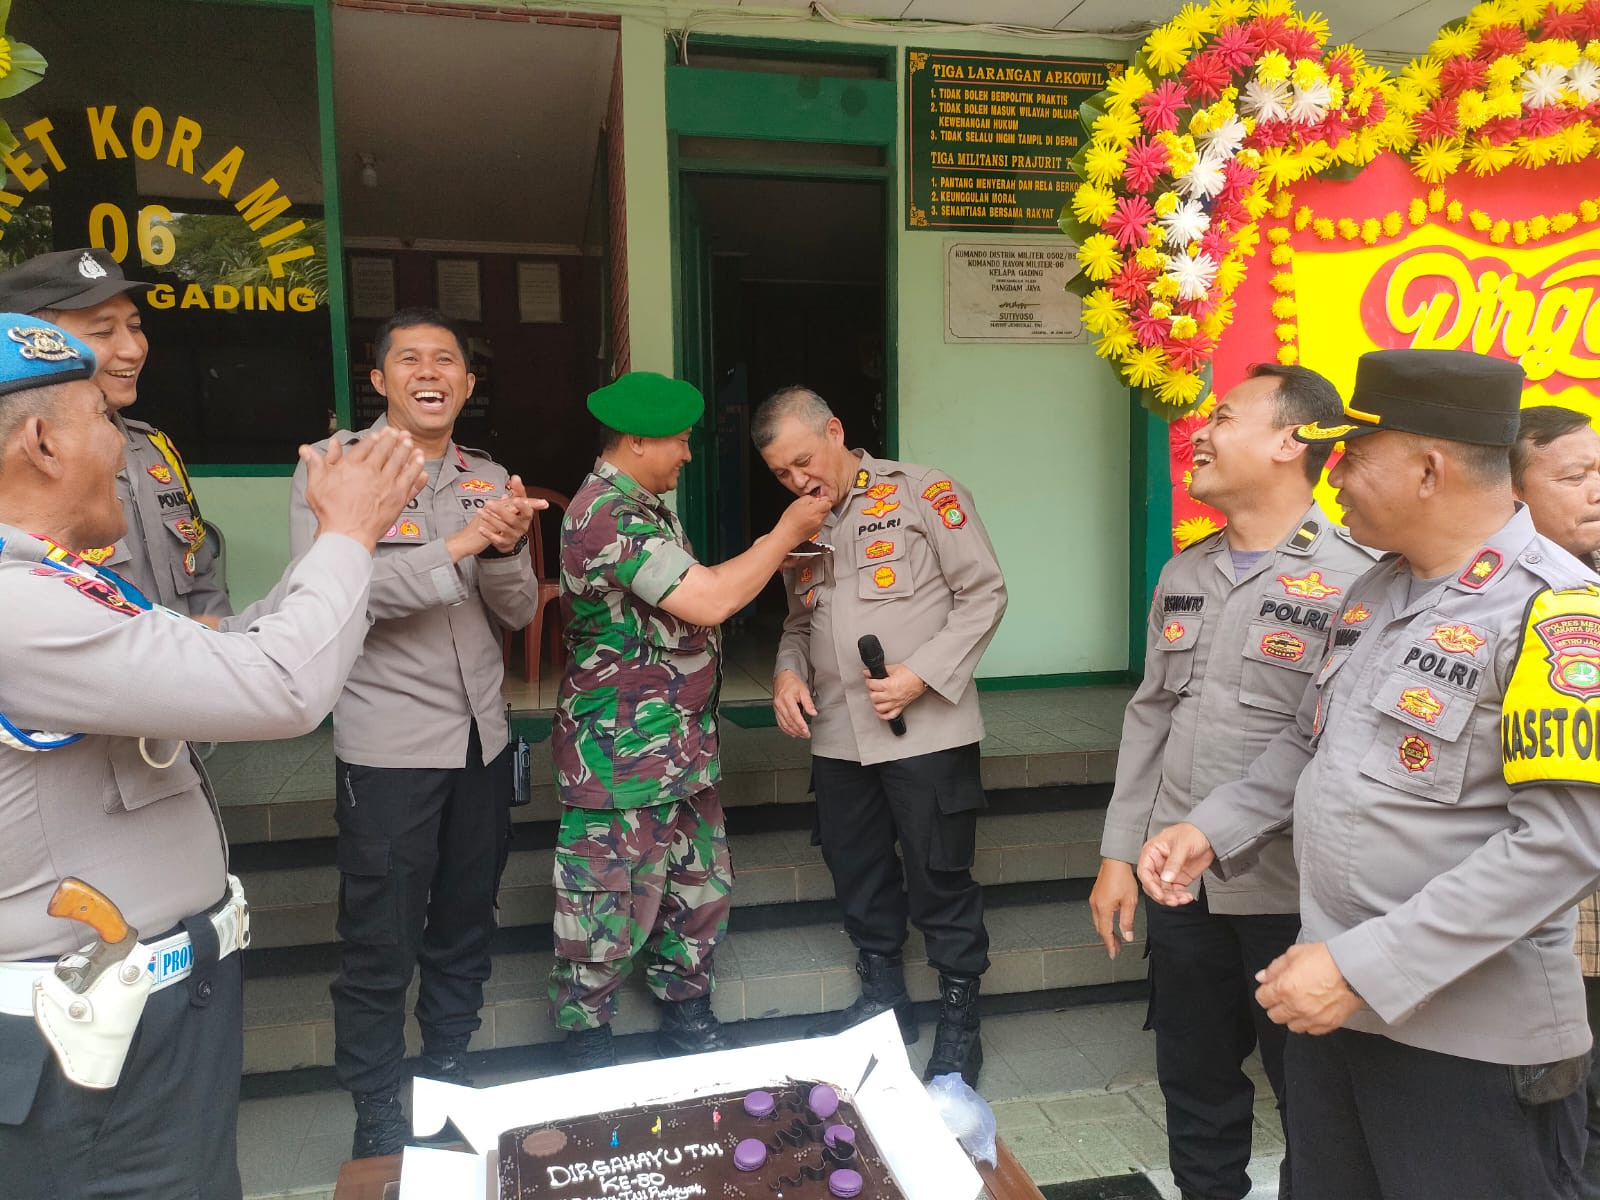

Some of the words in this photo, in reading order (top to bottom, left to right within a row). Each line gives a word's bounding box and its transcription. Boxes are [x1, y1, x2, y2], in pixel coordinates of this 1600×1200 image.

[932, 64, 964, 78] TIGA
[968, 67, 1042, 82] LARANGAN
[930, 89, 936, 98] 1.
[939, 88, 961, 99] TIDAK
[964, 89, 988, 100] BOLEH
[991, 91, 1033, 103] BERPOLITIK
[1036, 94, 1068, 106] PRAKTIS
[930, 102, 937, 112] 2.
[939, 102, 961, 114] TIDAK
[964, 104, 988, 114] BOLEH
[991, 105, 1016, 116] MASUK
[1019, 106, 1050, 118] WILAYAH
[1052, 108, 1078, 120] DILUAR
[939, 116, 990, 130] KEWENANGAN
[993, 119, 1018, 130] HUKUM
[930, 130, 937, 140] 3.
[940, 130, 962, 141] TIDAK
[966, 131, 992, 142] SELALU
[996, 134, 1015, 144] INGIN
[1018, 134, 1042, 146] TAMPIL
[1046, 136, 1052, 146] DI
[1056, 136, 1078, 147] DEPAN
[931, 152, 954, 165] TIGA
[958, 153, 1008, 166] MILITANSI
[1012, 155, 1061, 168] PRAJURIT
[87, 105, 315, 279] KORAMIL
[931, 178, 936, 187] 1.
[940, 177, 974, 190] PANTANG
[976, 178, 1016, 190] MENYERAH
[1018, 179, 1032, 191] DAN
[1034, 180, 1052, 192] RELA
[1056, 181, 1080, 192] BERKO
[932, 192, 938, 202] 2.
[940, 192, 989, 204] KEUNGGULAN
[992, 193, 1016, 204] MORAL
[931, 206, 938, 216] 3.
[941, 206, 986, 217] SENANTIASA
[990, 207, 1022, 218] BERSAMA
[1026, 208, 1054, 219] RAKYAT
[89, 203, 176, 265] 06
[956, 250, 987, 258] KOMANDO
[990, 250, 1015, 258] DISTRIK
[1018, 251, 1044, 259] MILITER
[968, 260, 1000, 268] KOMANDO
[1002, 260, 1024, 268] RAYON
[989, 268, 1016, 276] KELAPA
[992, 284, 1022, 292] PANGDAM
[1026, 284, 1041, 292] JAYA
[147, 284, 317, 312] GADING
[999, 312, 1034, 320] SUTIYOSO
[858, 518, 900, 536] POLRI
[1260, 600, 1329, 631] POLRI
[1545, 620, 1579, 632] POLRES
[1555, 638, 1582, 647] METRO
[1404, 646, 1479, 690] POLRI
[1503, 707, 1600, 764] KASETO
[547, 1148, 682, 1188] DIRGAHAYU
[684, 1143, 724, 1160] TNI
